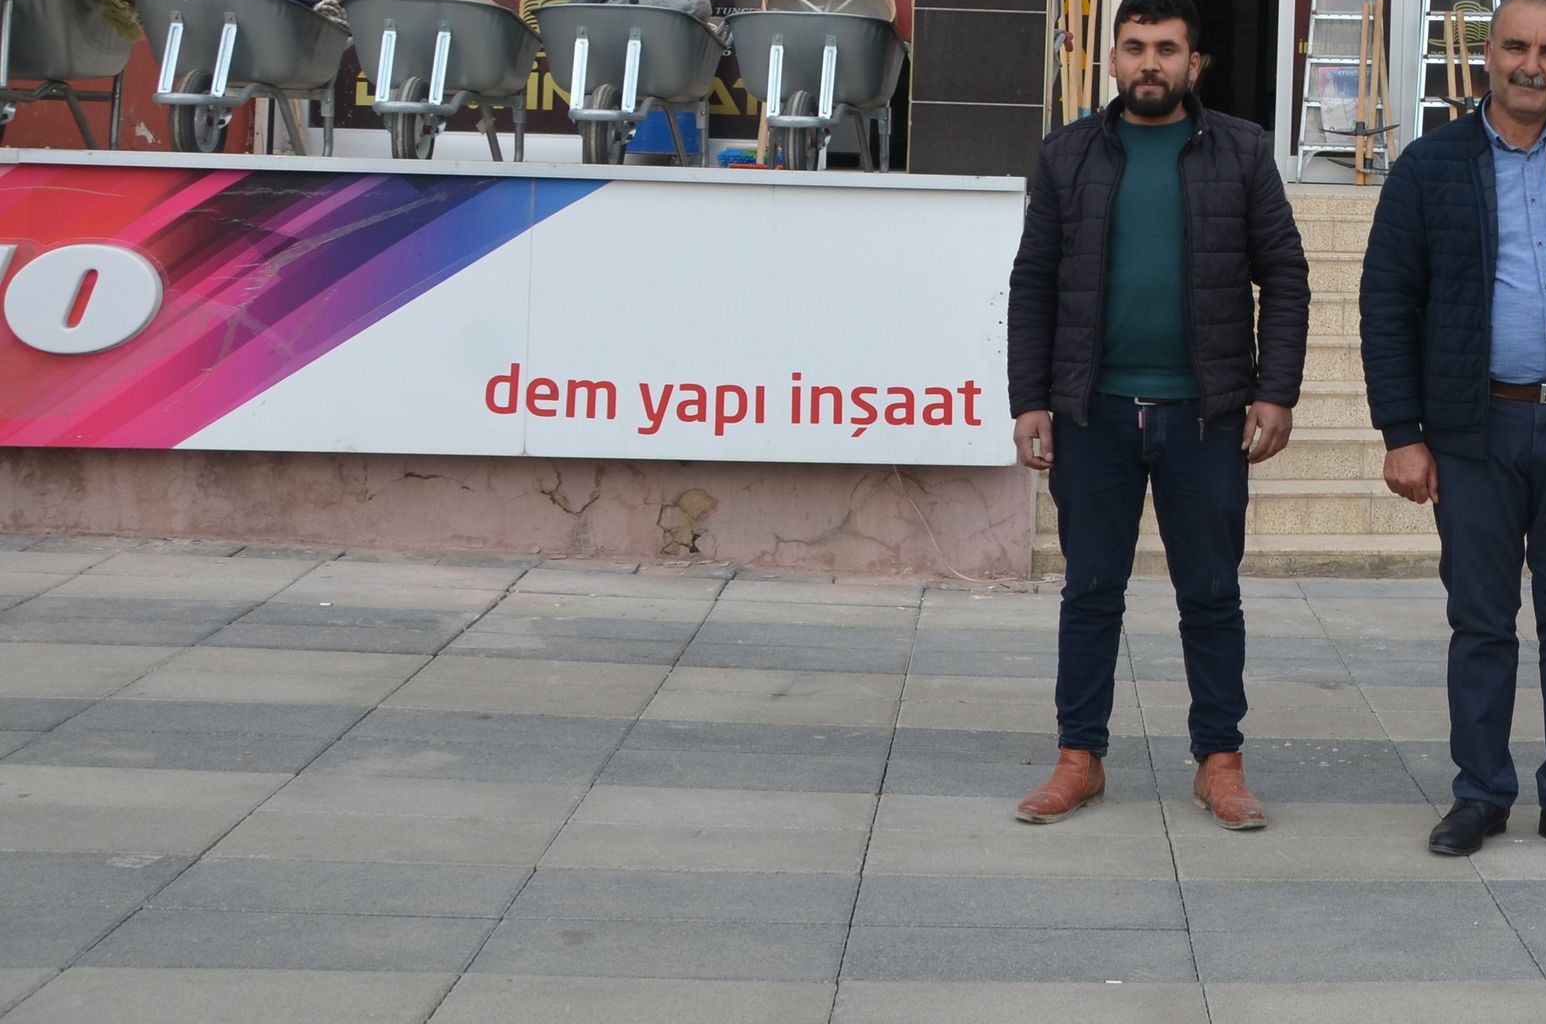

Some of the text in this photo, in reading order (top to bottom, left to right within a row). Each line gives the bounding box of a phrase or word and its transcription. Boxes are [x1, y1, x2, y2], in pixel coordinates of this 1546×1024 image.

[485, 362, 982, 439] dem yapı inşaat
